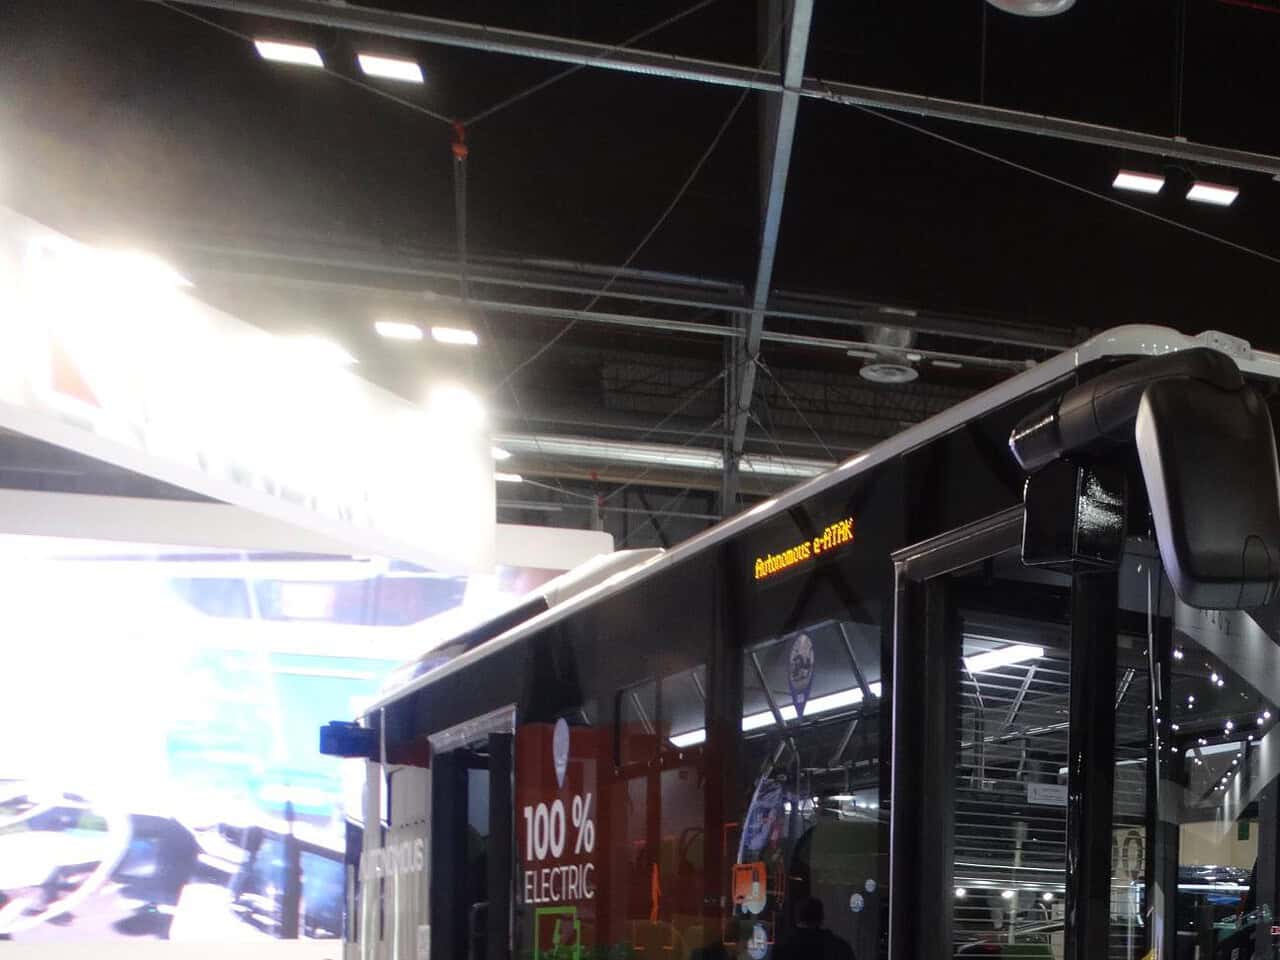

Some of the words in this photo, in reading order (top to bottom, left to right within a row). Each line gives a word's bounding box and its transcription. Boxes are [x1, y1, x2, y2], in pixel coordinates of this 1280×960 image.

[754, 541, 812, 580] Autonomous
[813, 517, 855, 554] e-ATAK
[524, 799, 566, 861] 100
[572, 792, 595, 855] %
[525, 862, 595, 904] ELECTRIC
